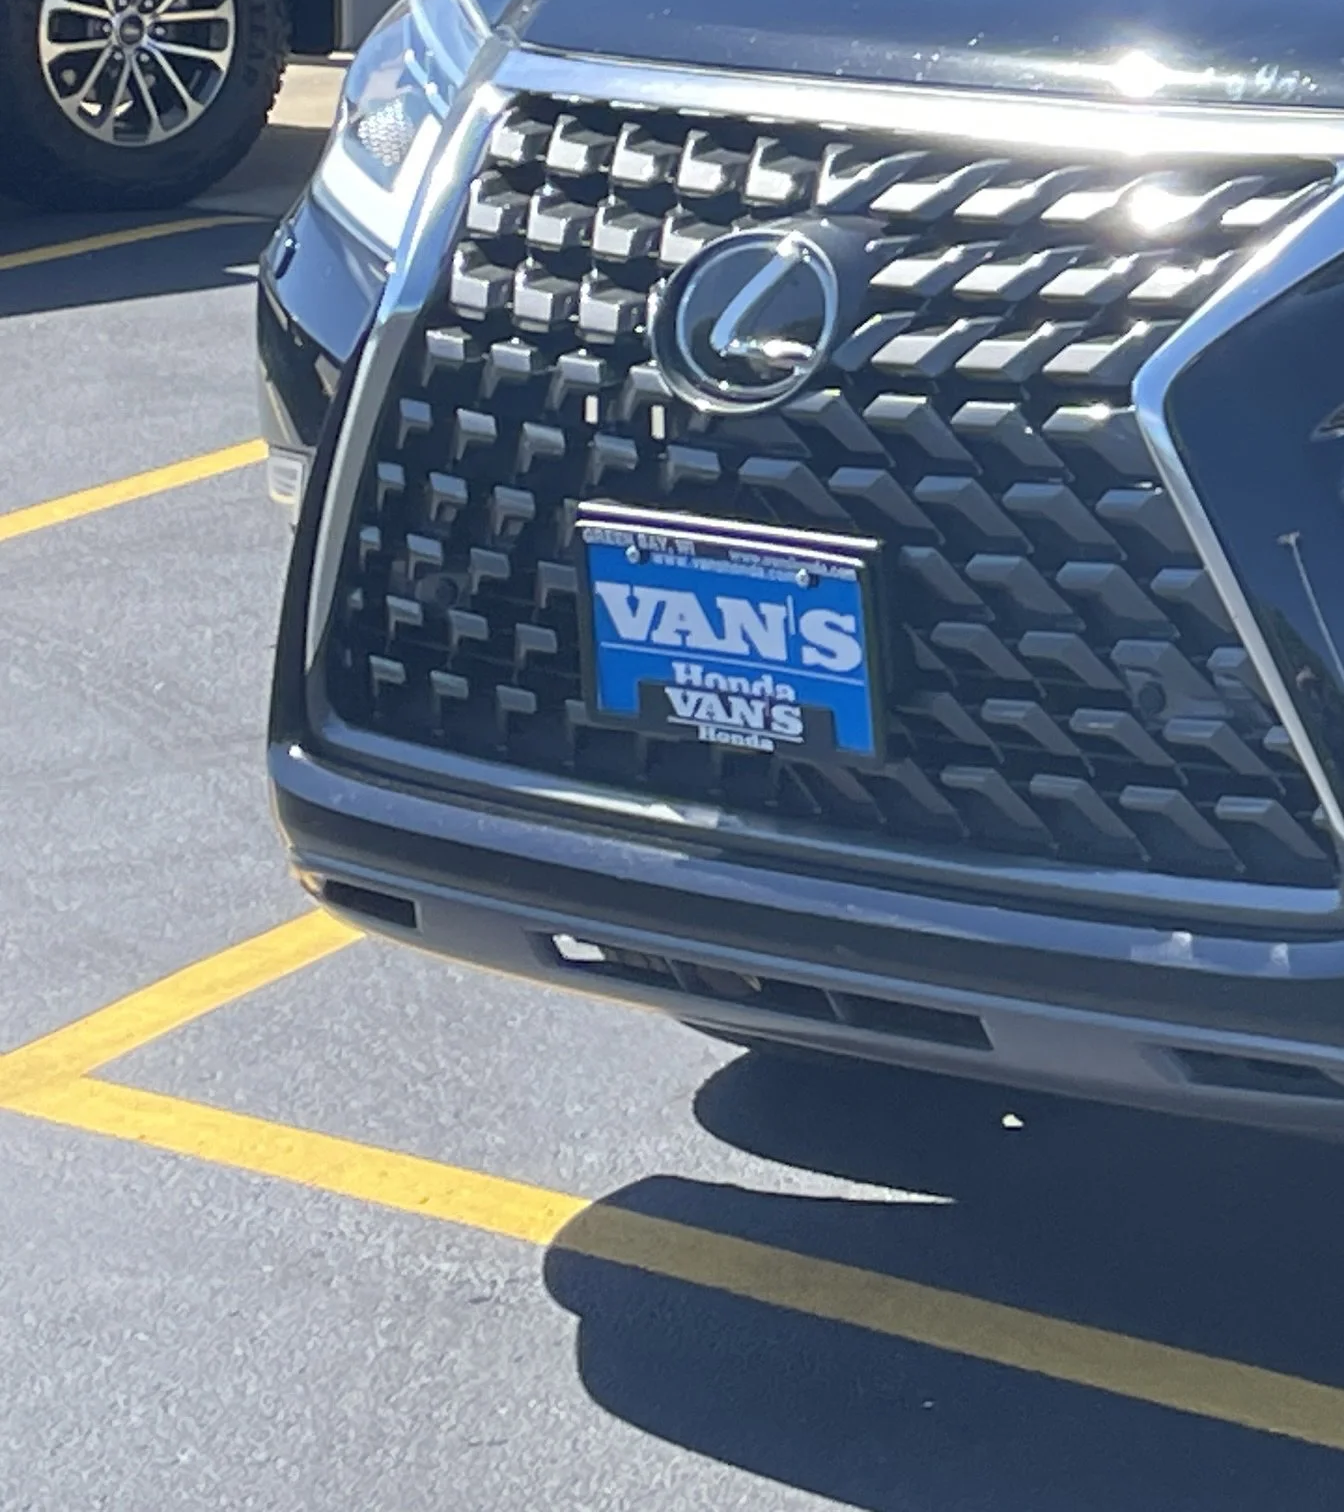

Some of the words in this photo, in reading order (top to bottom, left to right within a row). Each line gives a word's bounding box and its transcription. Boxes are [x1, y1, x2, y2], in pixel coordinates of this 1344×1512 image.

[594, 581, 863, 672] VAN'S
[671, 661, 797, 703] Honda
[698, 725, 775, 752] Honda
